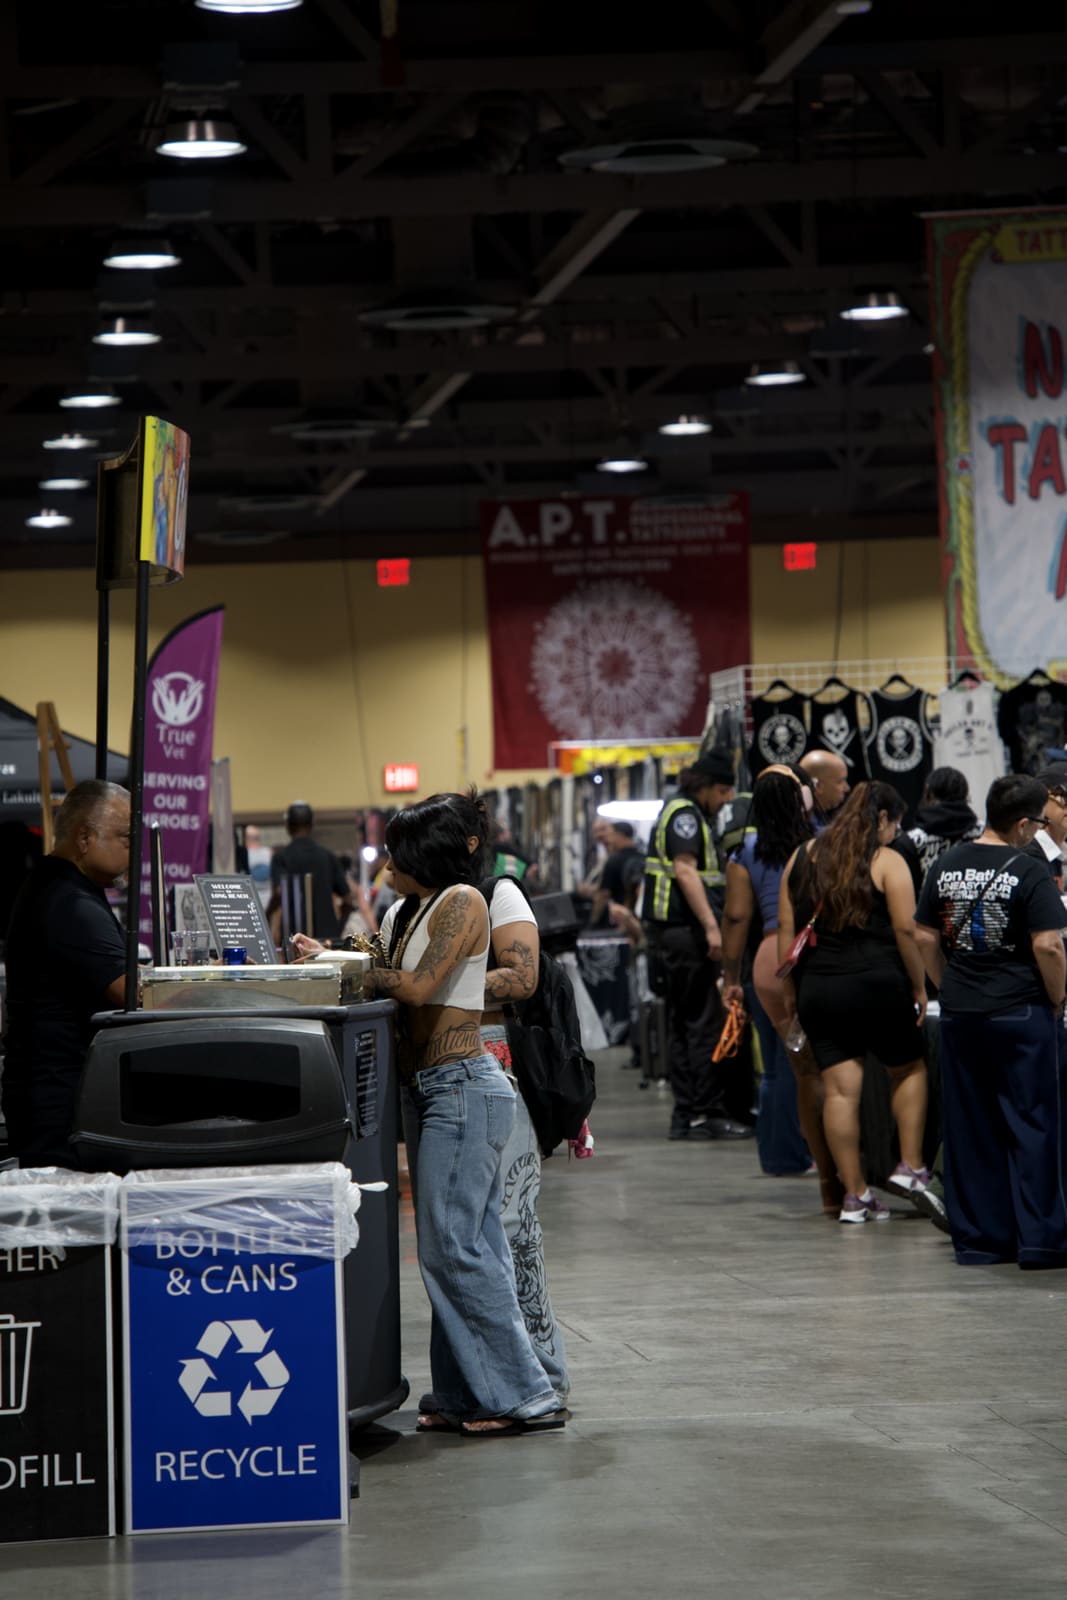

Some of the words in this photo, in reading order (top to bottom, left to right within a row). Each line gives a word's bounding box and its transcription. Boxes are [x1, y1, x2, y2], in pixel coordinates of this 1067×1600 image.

[488, 500, 628, 548] A.P.T.
[155, 724, 196, 746] True
[153, 794, 188, 810] OUR
[937, 870, 963, 885] Jon
[166, 1267, 192, 1296] &
[200, 1262, 298, 1295] CANS
[155, 1444, 318, 1482] RECYCLE
